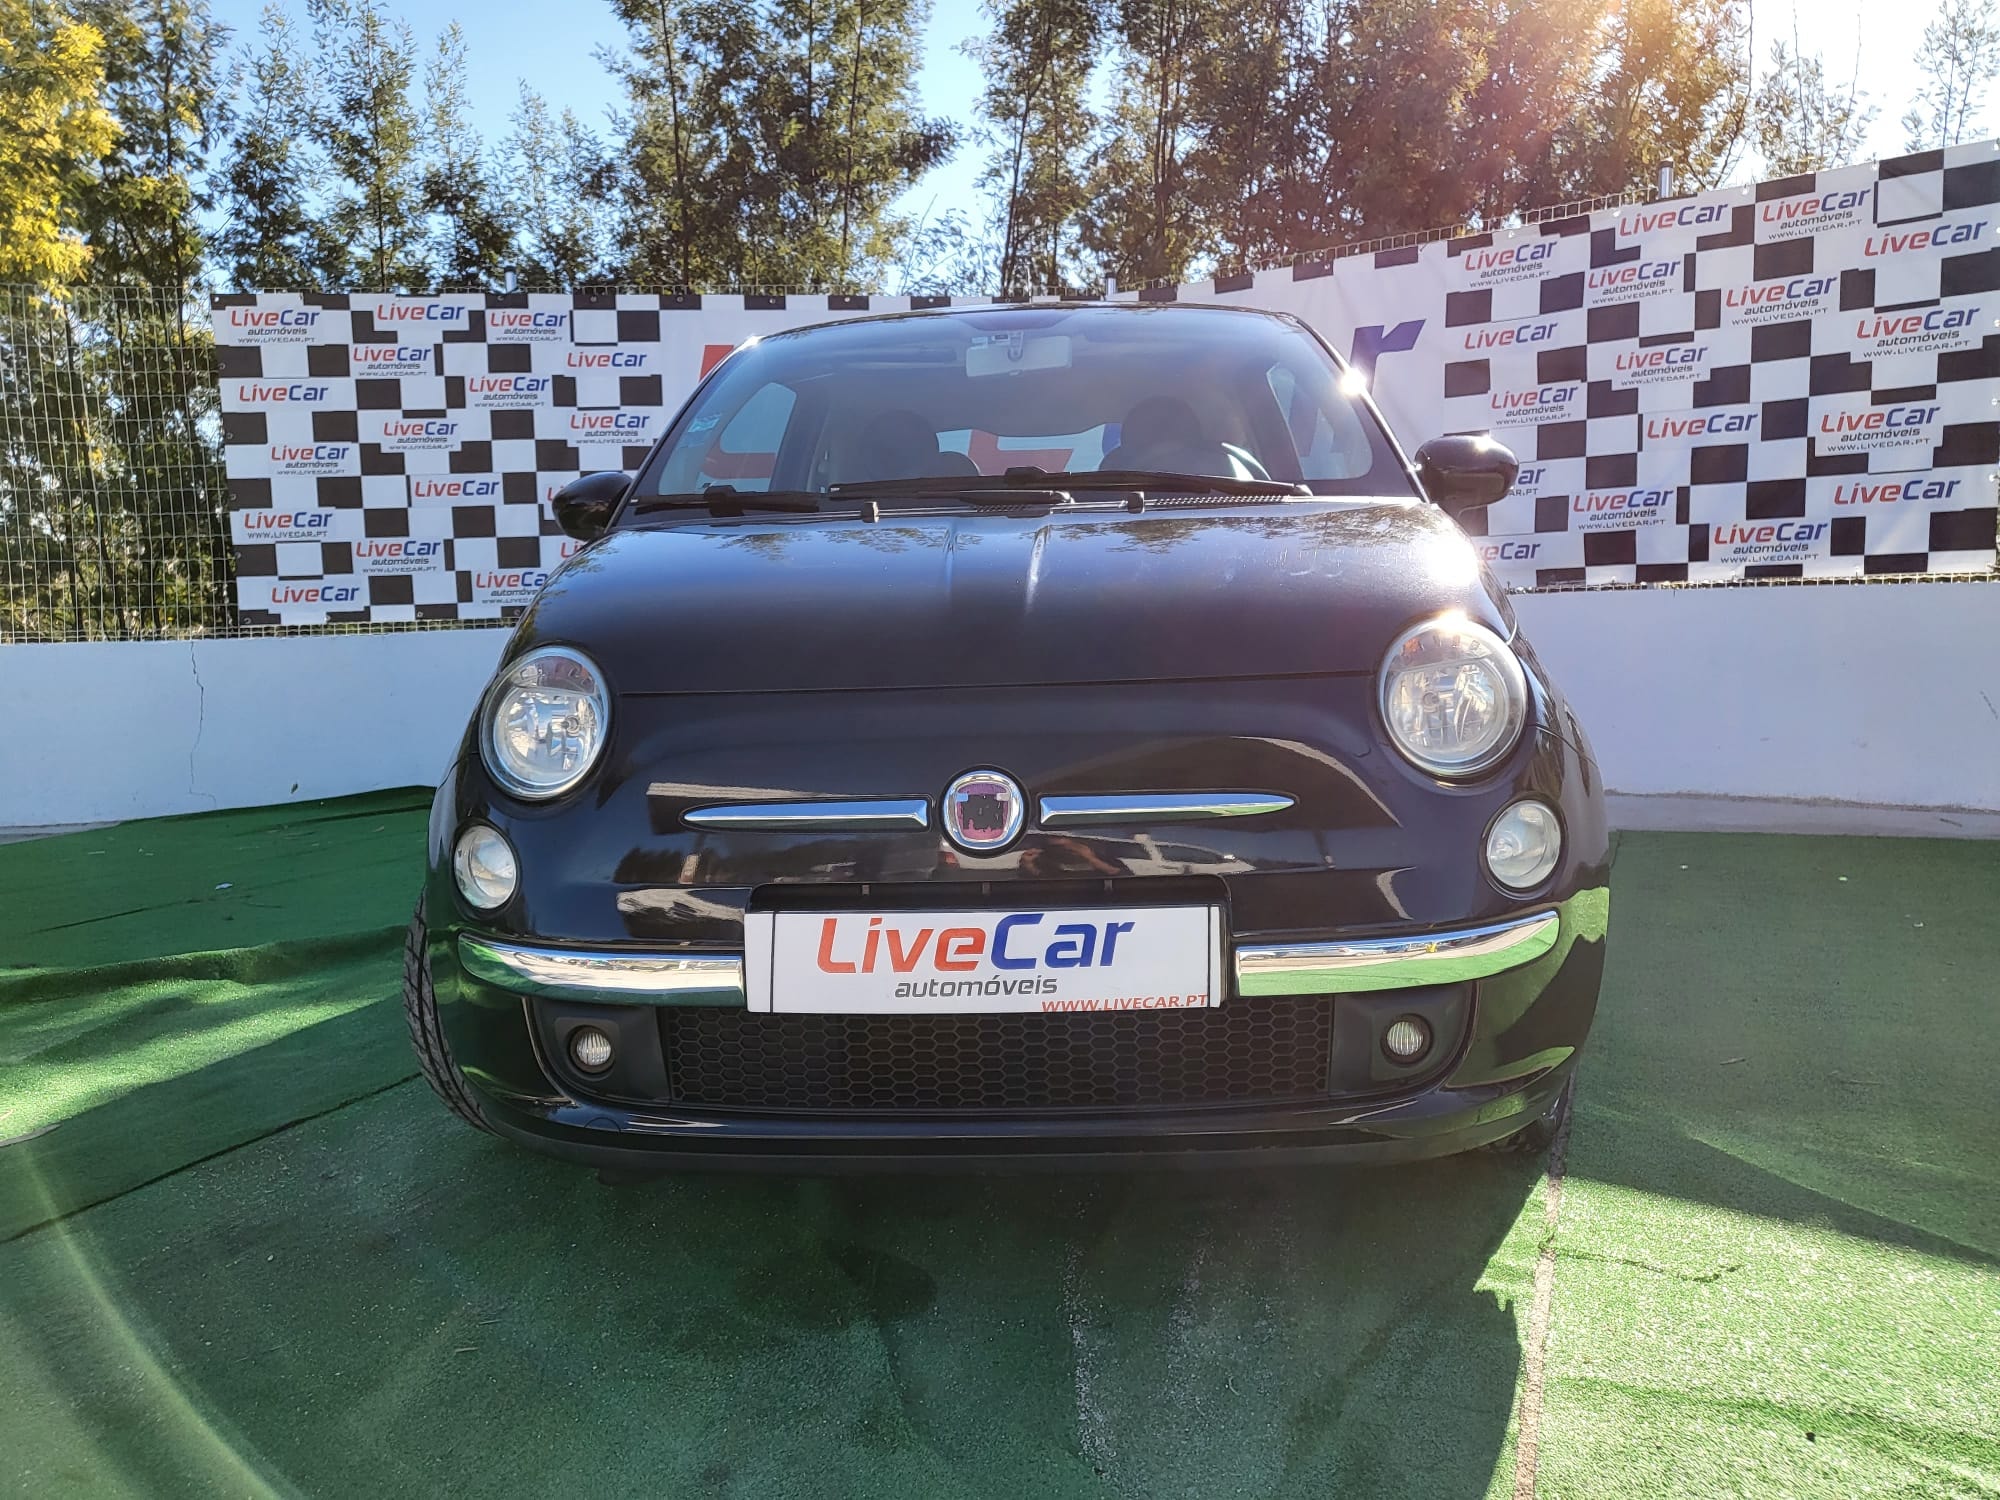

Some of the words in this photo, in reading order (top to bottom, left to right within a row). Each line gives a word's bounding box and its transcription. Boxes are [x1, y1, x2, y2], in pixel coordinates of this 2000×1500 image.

[1763, 189, 1871, 222] LiveCar
[1620, 204, 1728, 236] LiveCar
[1780, 210, 1853, 230] automóveis
[1865, 222, 1988, 256] LiveCar
[1465, 242, 1557, 271] LiveCar
[1480, 261, 1542, 279] automóveis
[1589, 261, 1680, 288] LiveCar
[1602, 279, 1665, 295] automóveis
[1726, 277, 1837, 307] LiveCar
[377, 303, 464, 320] LiveCar
[1744, 298, 1819, 315] automóveis
[232, 309, 320, 326] LiveCar
[491, 312, 567, 327] LiveCar
[1857, 308, 1981, 339] LiveCar
[1465, 323, 1557, 349] LiveCar
[1877, 330, 1959, 347] automóveis
[354, 346, 431, 361] LiveCar
[568, 352, 647, 367] LiveCar
[1616, 347, 1708, 370] LiveCar
[1631, 364, 1692, 377] automóveis
[240, 384, 328, 401] LiveCar
[469, 377, 549, 392] LiveCar
[1491, 387, 1578, 409] LiveCar
[1505, 404, 1564, 417] automóveis
[571, 414, 649, 429] LiveCar
[1648, 413, 1758, 438] LiveCar
[1821, 406, 1941, 433] LiveCar
[384, 421, 457, 436] LiveCar
[1841, 428, 1920, 442] automóveis
[272, 446, 349, 460] LiveCar
[415, 480, 499, 497] LiveCar
[1834, 480, 1961, 505] LiveCar
[1573, 489, 1674, 512] LiveCar
[245, 512, 332, 529] LiveCar
[1590, 508, 1657, 521] automóveis
[1715, 522, 1828, 544] LiveCar
[356, 541, 440, 558] LiveCar
[1733, 543, 1809, 554] automóveis
[476, 572, 548, 588] LiveCa
[272, 586, 359, 603] LiveCar
[817, 913, 1136, 974] LiveCar
[895, 975, 1058, 998] automóveis
[1041, 994, 1208, 1013] WWW.LIVECAR.PT
